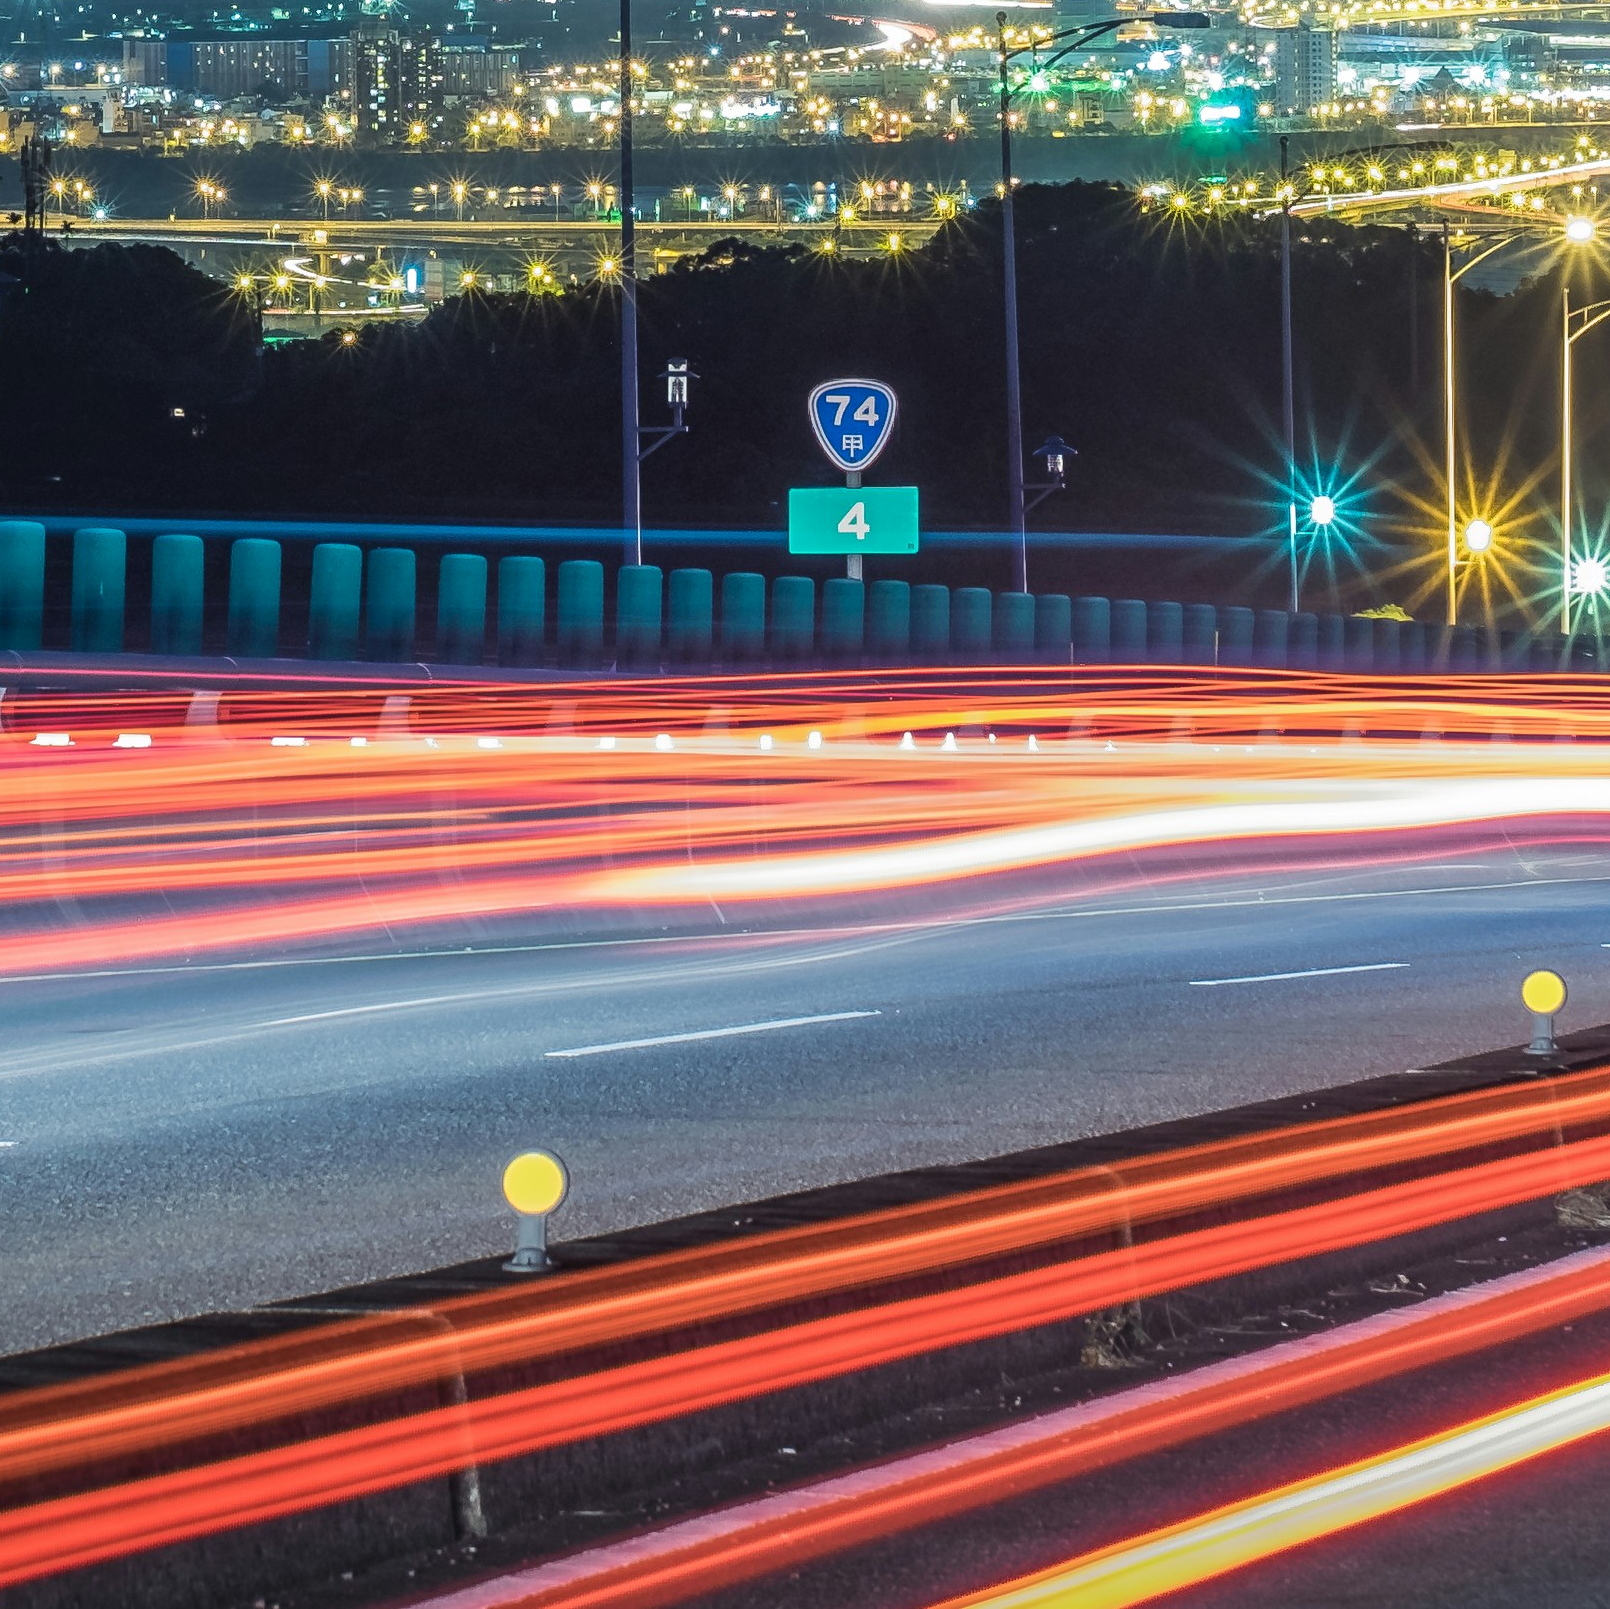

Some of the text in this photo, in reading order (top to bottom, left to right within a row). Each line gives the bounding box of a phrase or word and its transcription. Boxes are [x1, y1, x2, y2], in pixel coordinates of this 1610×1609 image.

[825, 395, 879, 426] 74
[842, 434, 863, 457] 甲
[838, 502, 870, 540] 4
